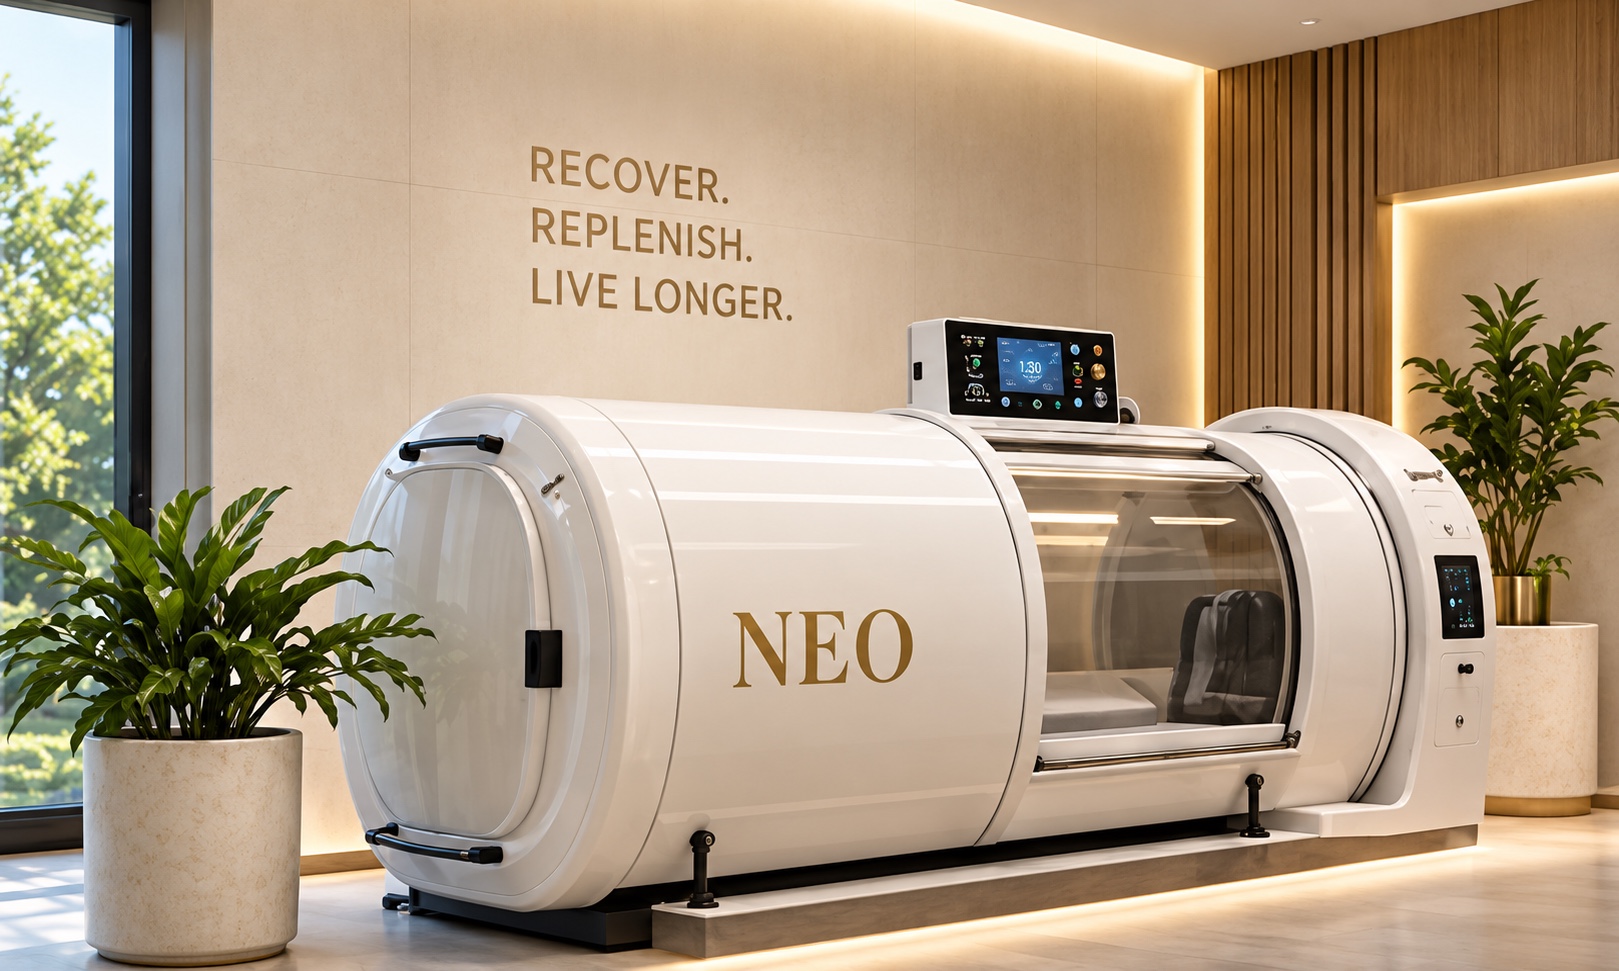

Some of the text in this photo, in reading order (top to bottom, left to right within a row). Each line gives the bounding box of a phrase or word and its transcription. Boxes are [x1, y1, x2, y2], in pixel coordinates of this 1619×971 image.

[531, 146, 729, 205] RECOVER.
[531, 207, 753, 263] REPLENISH.
[531, 267, 793, 322] LIVE LONGER.
[732, 608, 914, 689] NEO
